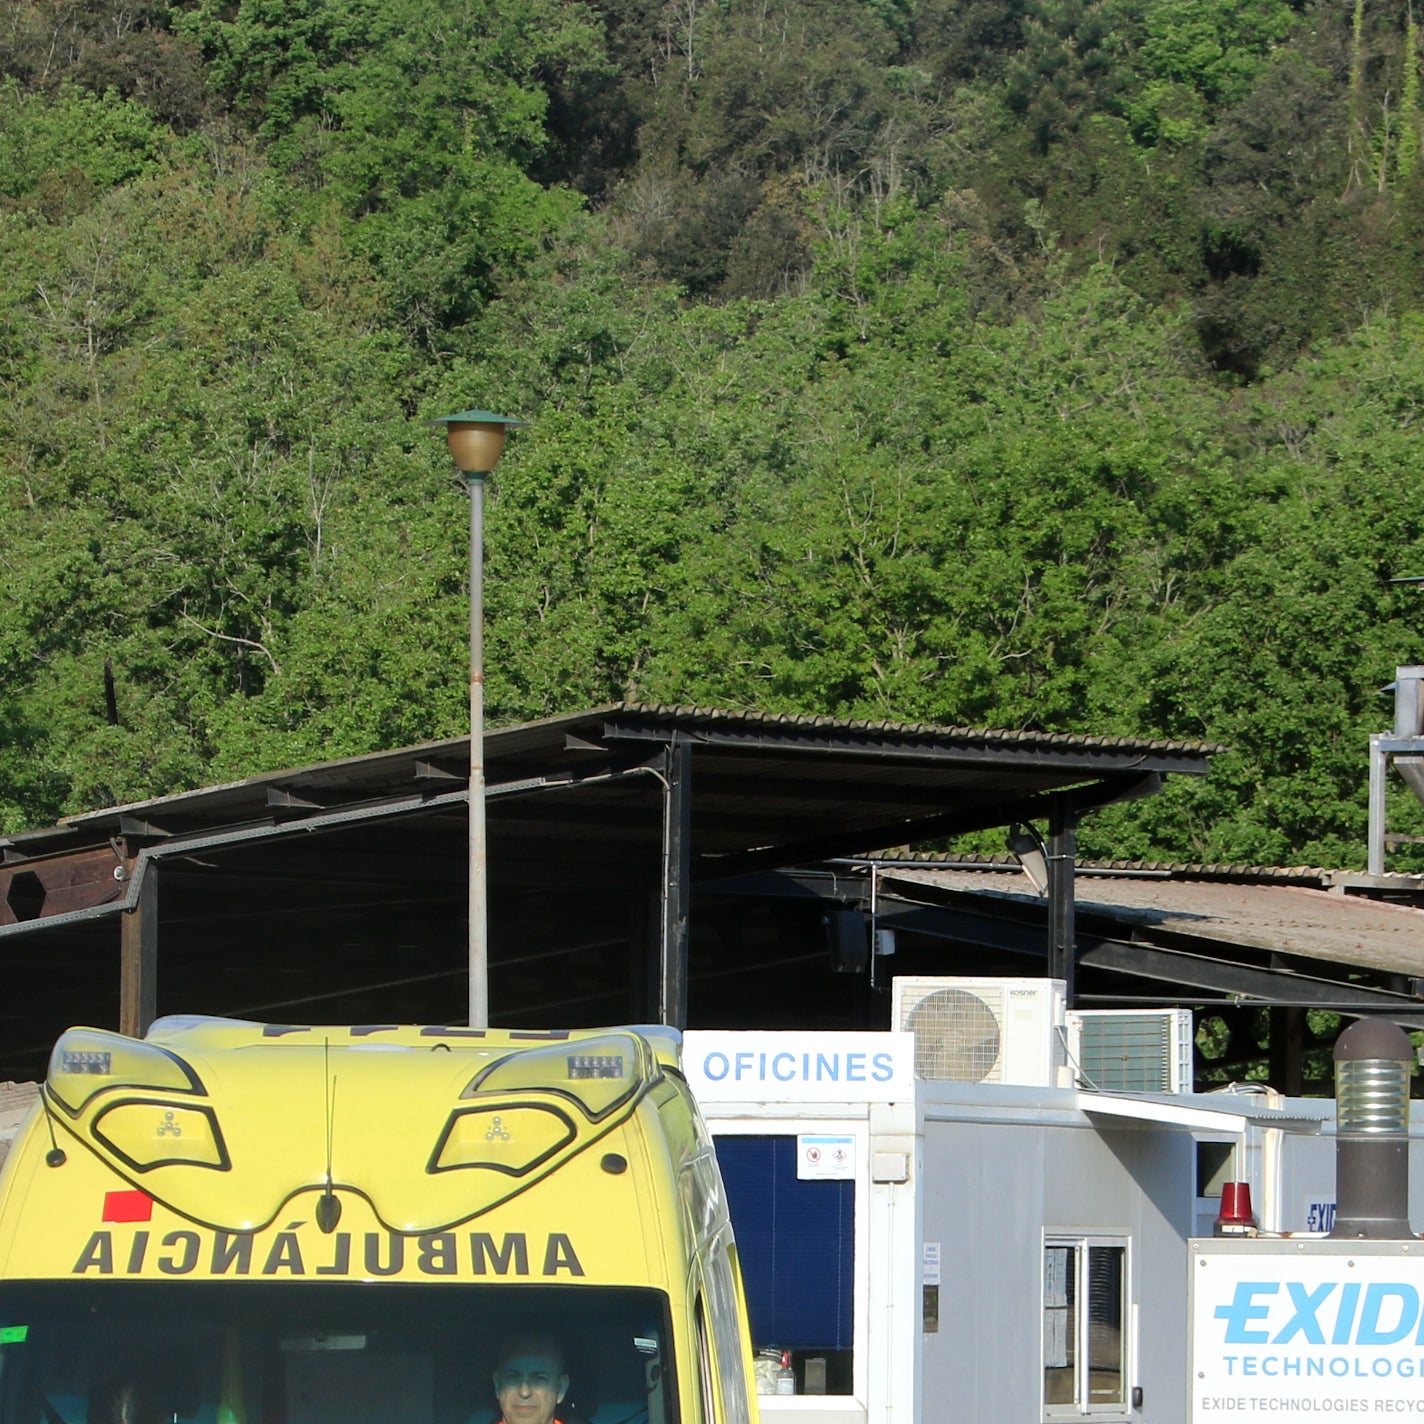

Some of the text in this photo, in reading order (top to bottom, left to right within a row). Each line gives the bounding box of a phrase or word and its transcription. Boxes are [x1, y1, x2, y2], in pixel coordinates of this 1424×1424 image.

[703, 1051, 894, 1082] OFICINES
[1202, 1397, 1246, 1411] EXIDE
[1251, 1397, 1369, 1412] TECHNOLOGIES
